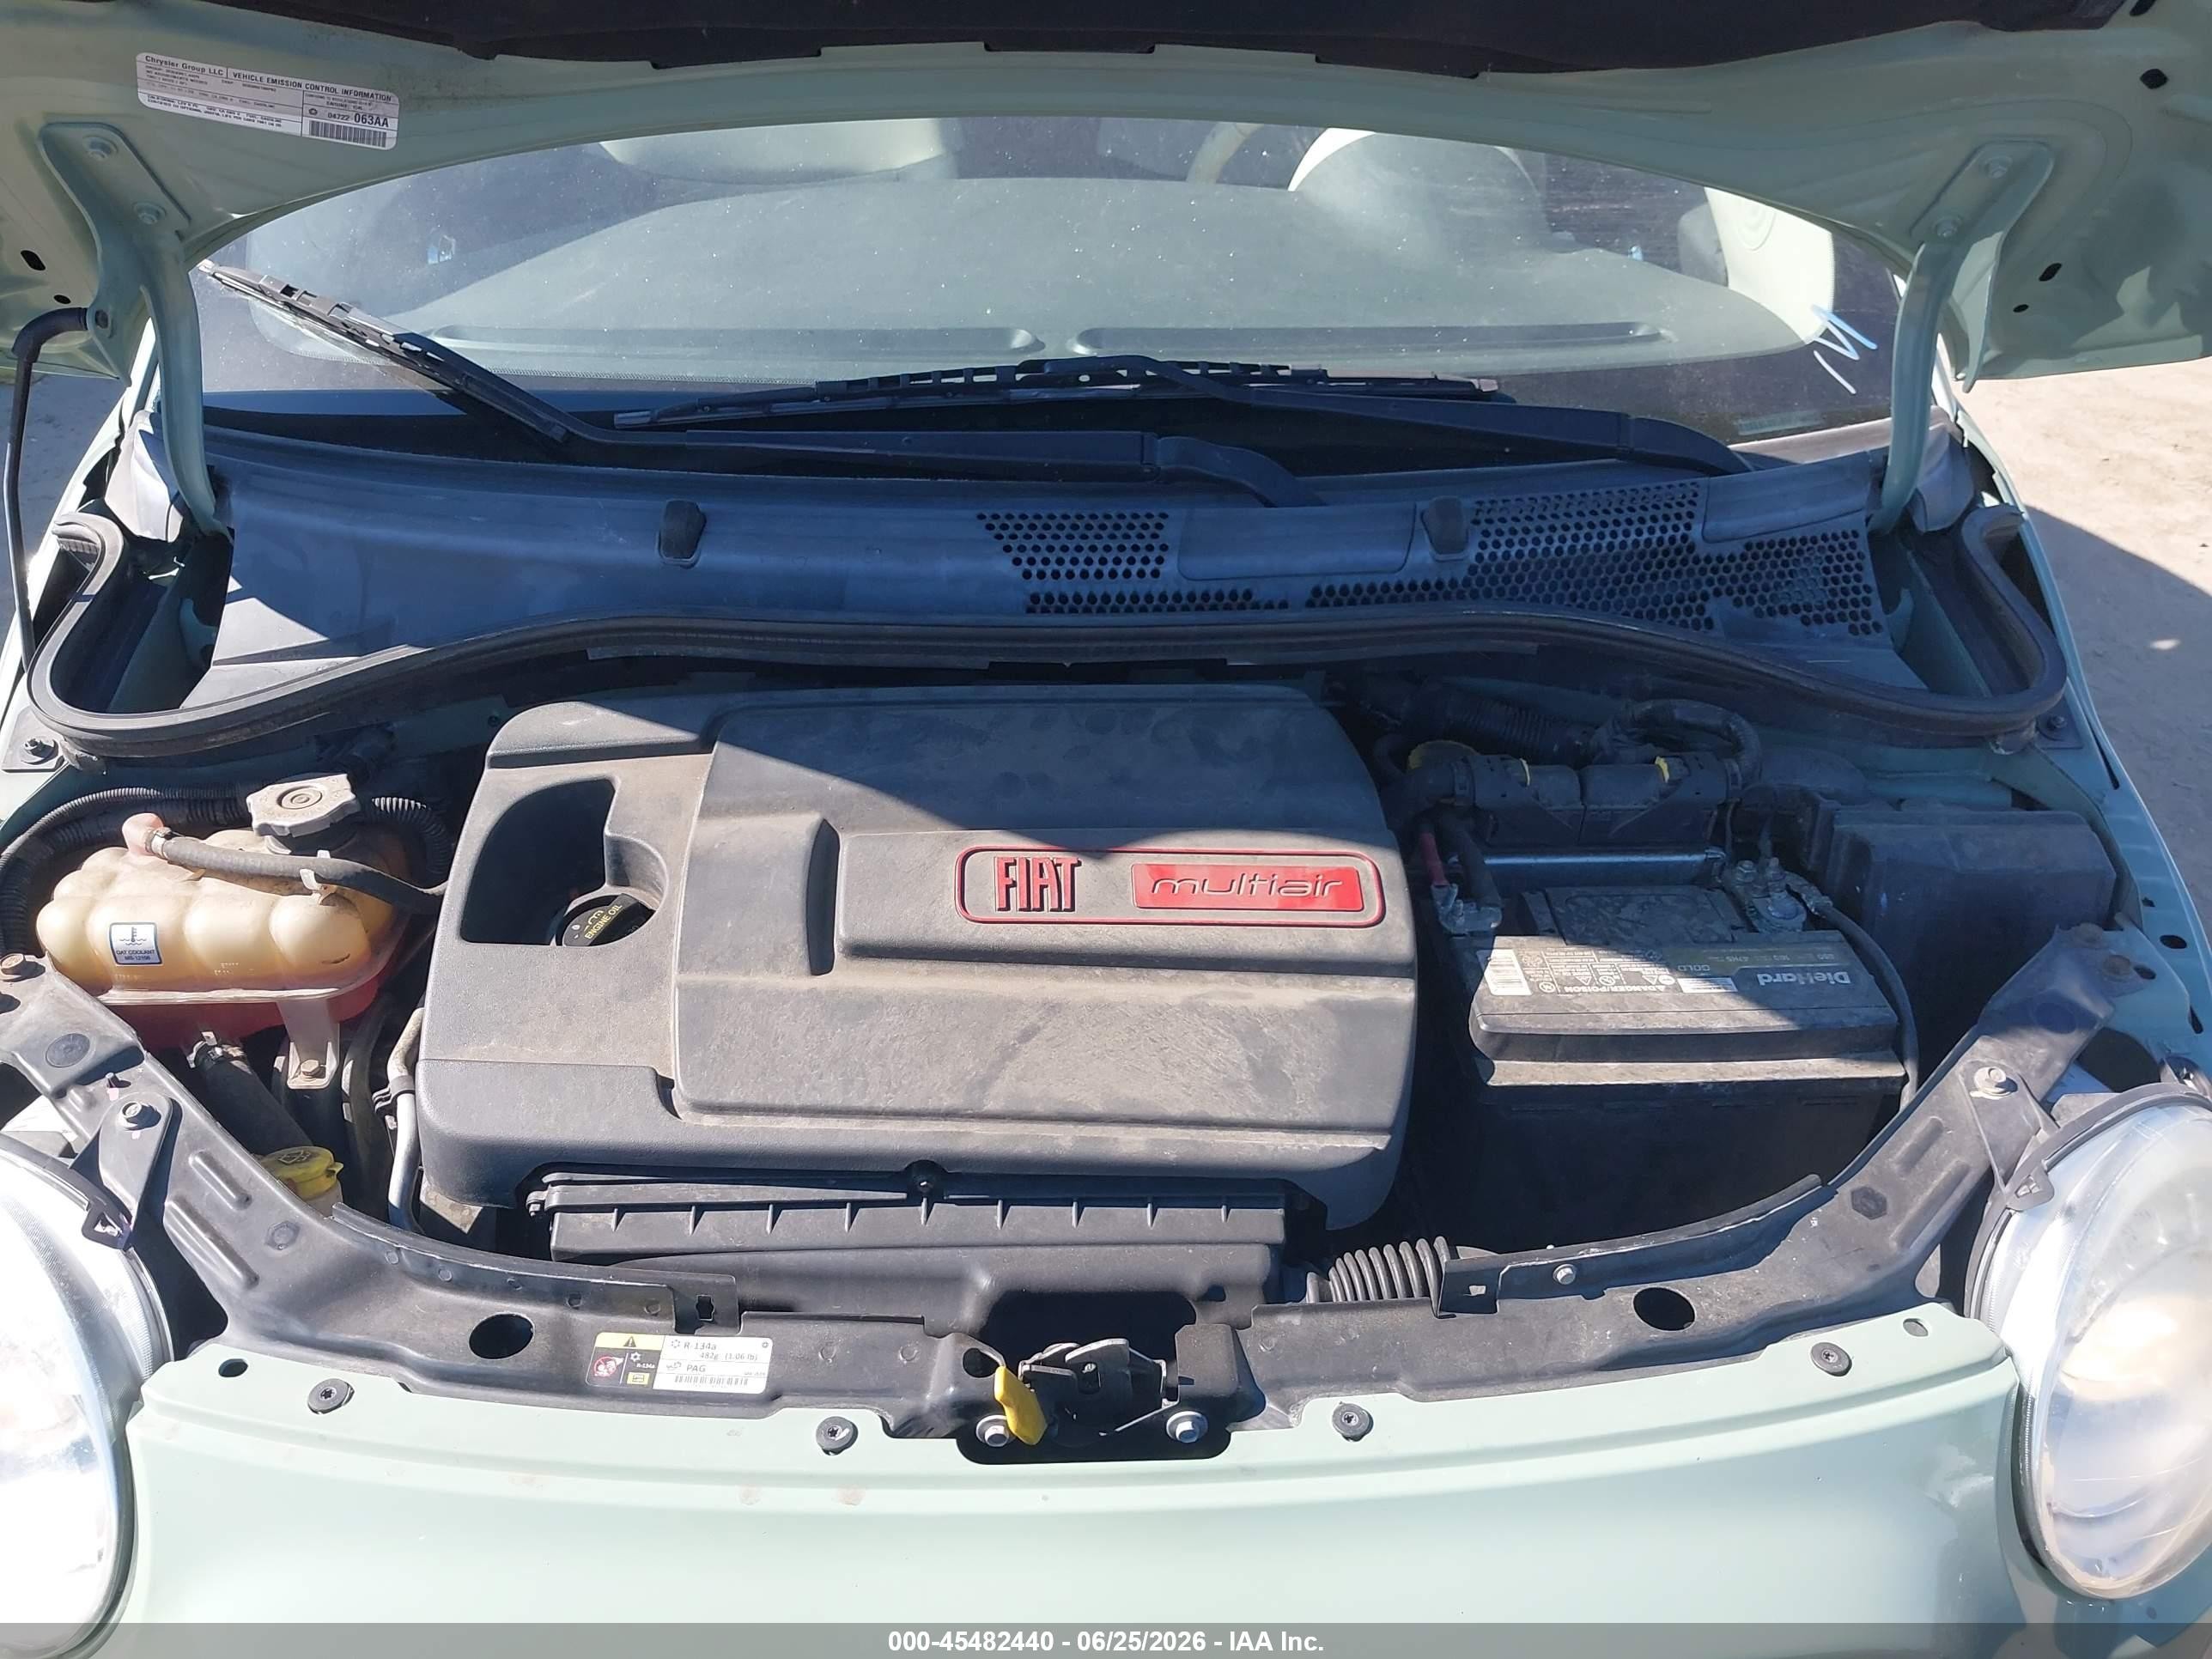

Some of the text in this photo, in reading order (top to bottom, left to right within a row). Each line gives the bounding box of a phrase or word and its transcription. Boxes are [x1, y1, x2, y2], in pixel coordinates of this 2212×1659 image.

[145, 55, 179, 68] Chrysler
[181, 63, 206, 75] Group
[209, 66, 224, 76] LLC
[233, 72, 264, 83] VEHICLE
[266, 77, 302, 88] EMISSION
[305, 83, 338, 94] CONTROL
[341, 88, 392, 102] INFORMATION
[327, 112, 390, 128] 04722 063AA
[996, 857, 1083, 913] FIAT
[1151, 872, 1344, 898] multiair
[584, 904, 623, 939] ENGINE OIL
[1756, 970, 1851, 986] DieHard
[684, 1341, 717, 1351] R-134a
[746, 1352, 758, 1362] lb)
[686, 1364, 706, 1373] PAG
